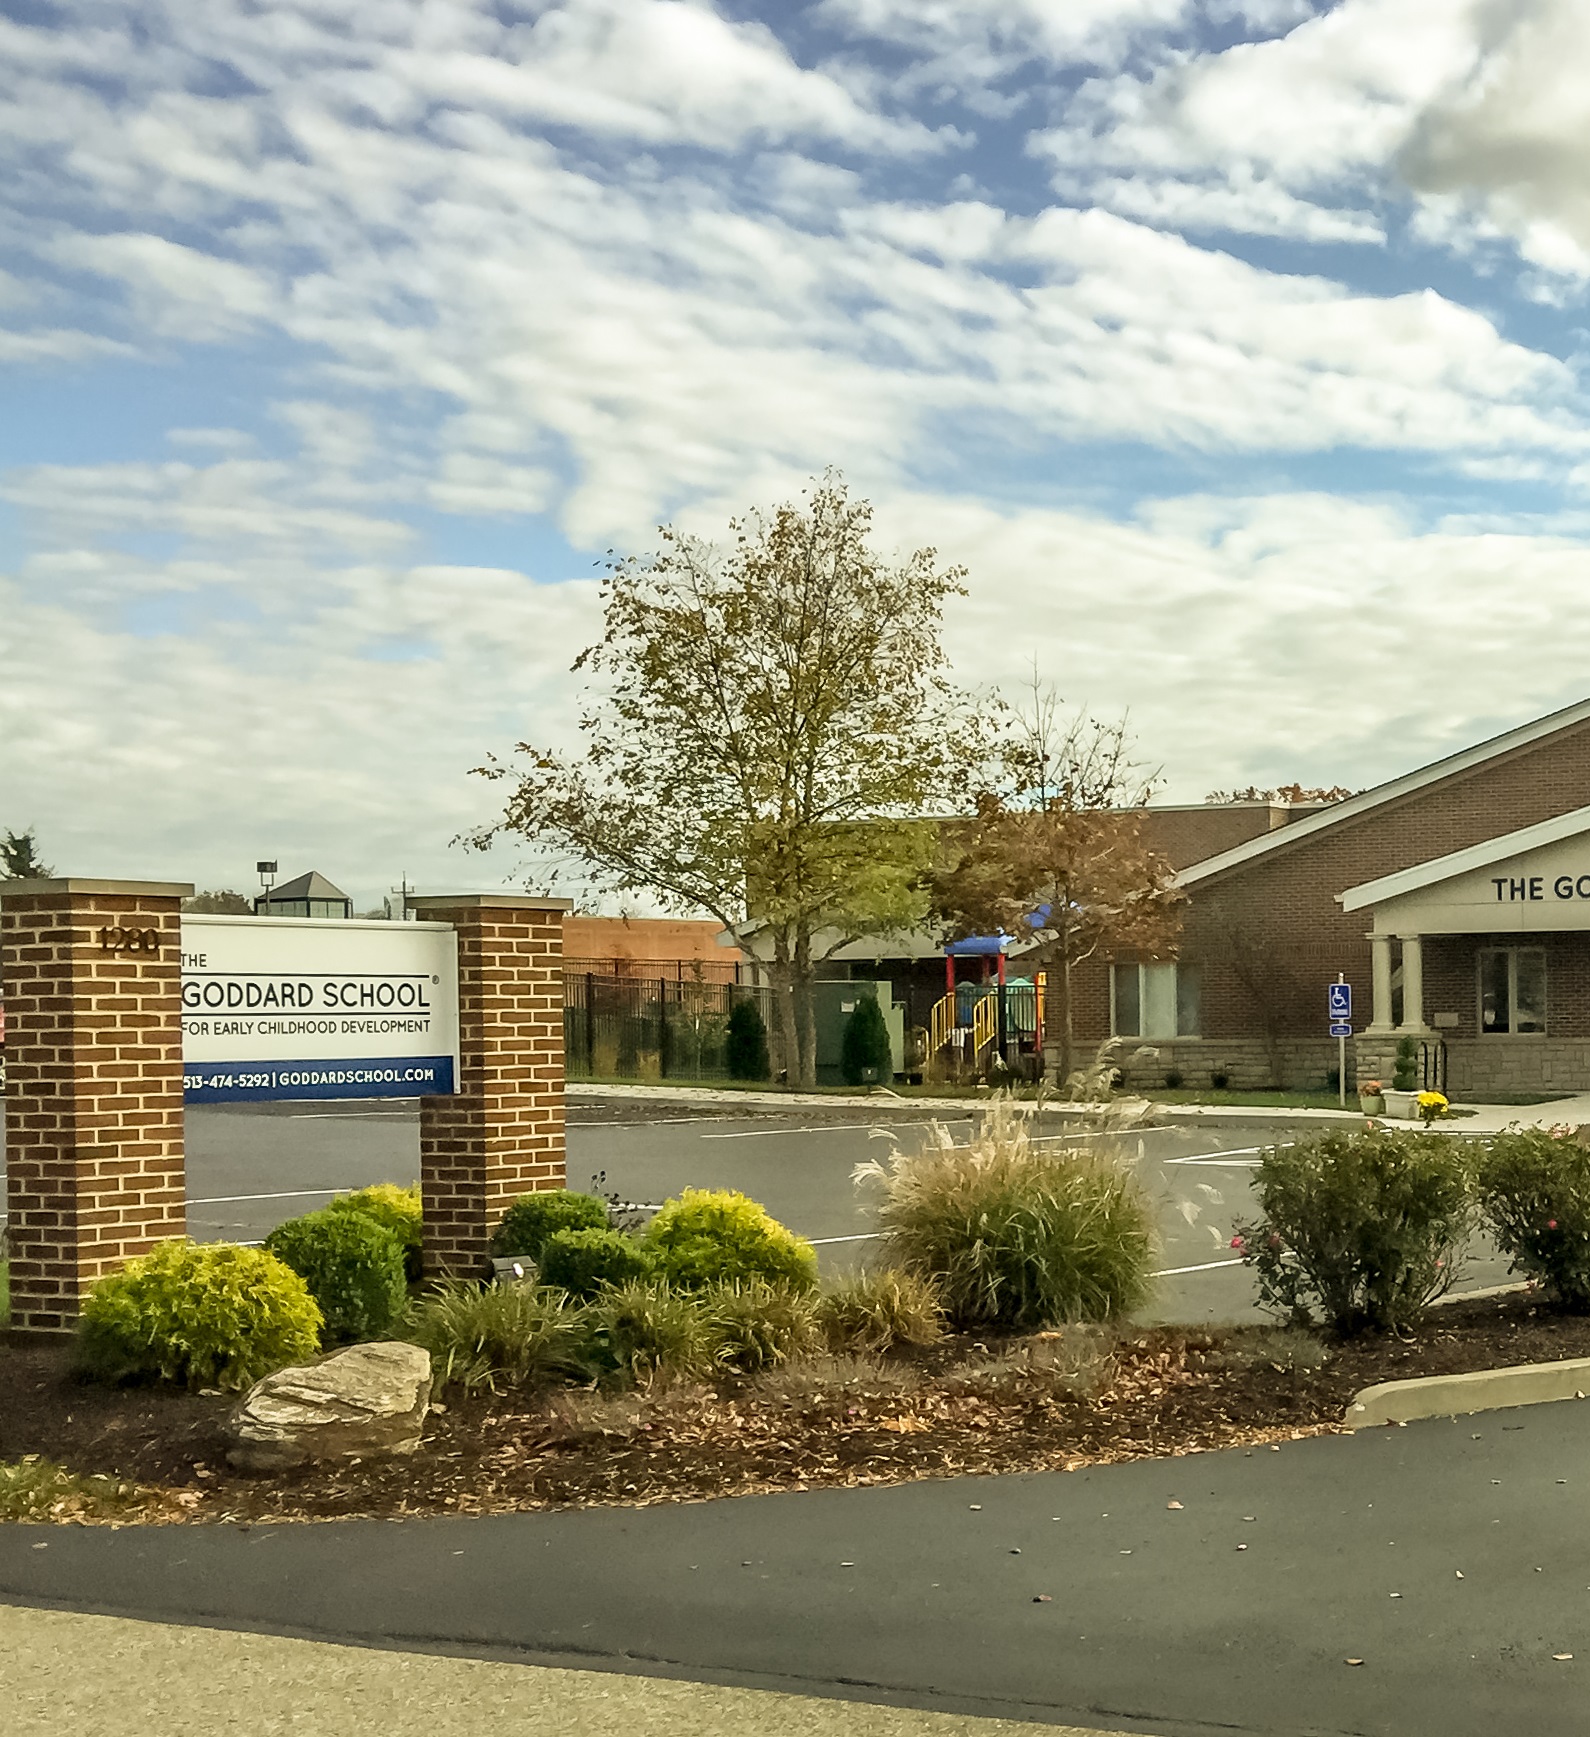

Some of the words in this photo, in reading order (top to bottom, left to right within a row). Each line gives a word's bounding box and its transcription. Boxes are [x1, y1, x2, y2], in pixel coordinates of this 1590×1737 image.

[1491, 876, 1544, 901] THE
[100, 926, 159, 954] 1280
[181, 953, 207, 968] THE
[182, 981, 314, 1008] GODDARD
[323, 982, 430, 1007] SCHOOL
[214, 1021, 254, 1035] EARLY
[257, 1020, 337, 1034] CHILDHOOD
[341, 1019, 431, 1034] DEVELOPMENT
[183, 1074, 270, 1090] 513-474-5292
[279, 1069, 434, 1086] GODDARDSCHOOL.COM
